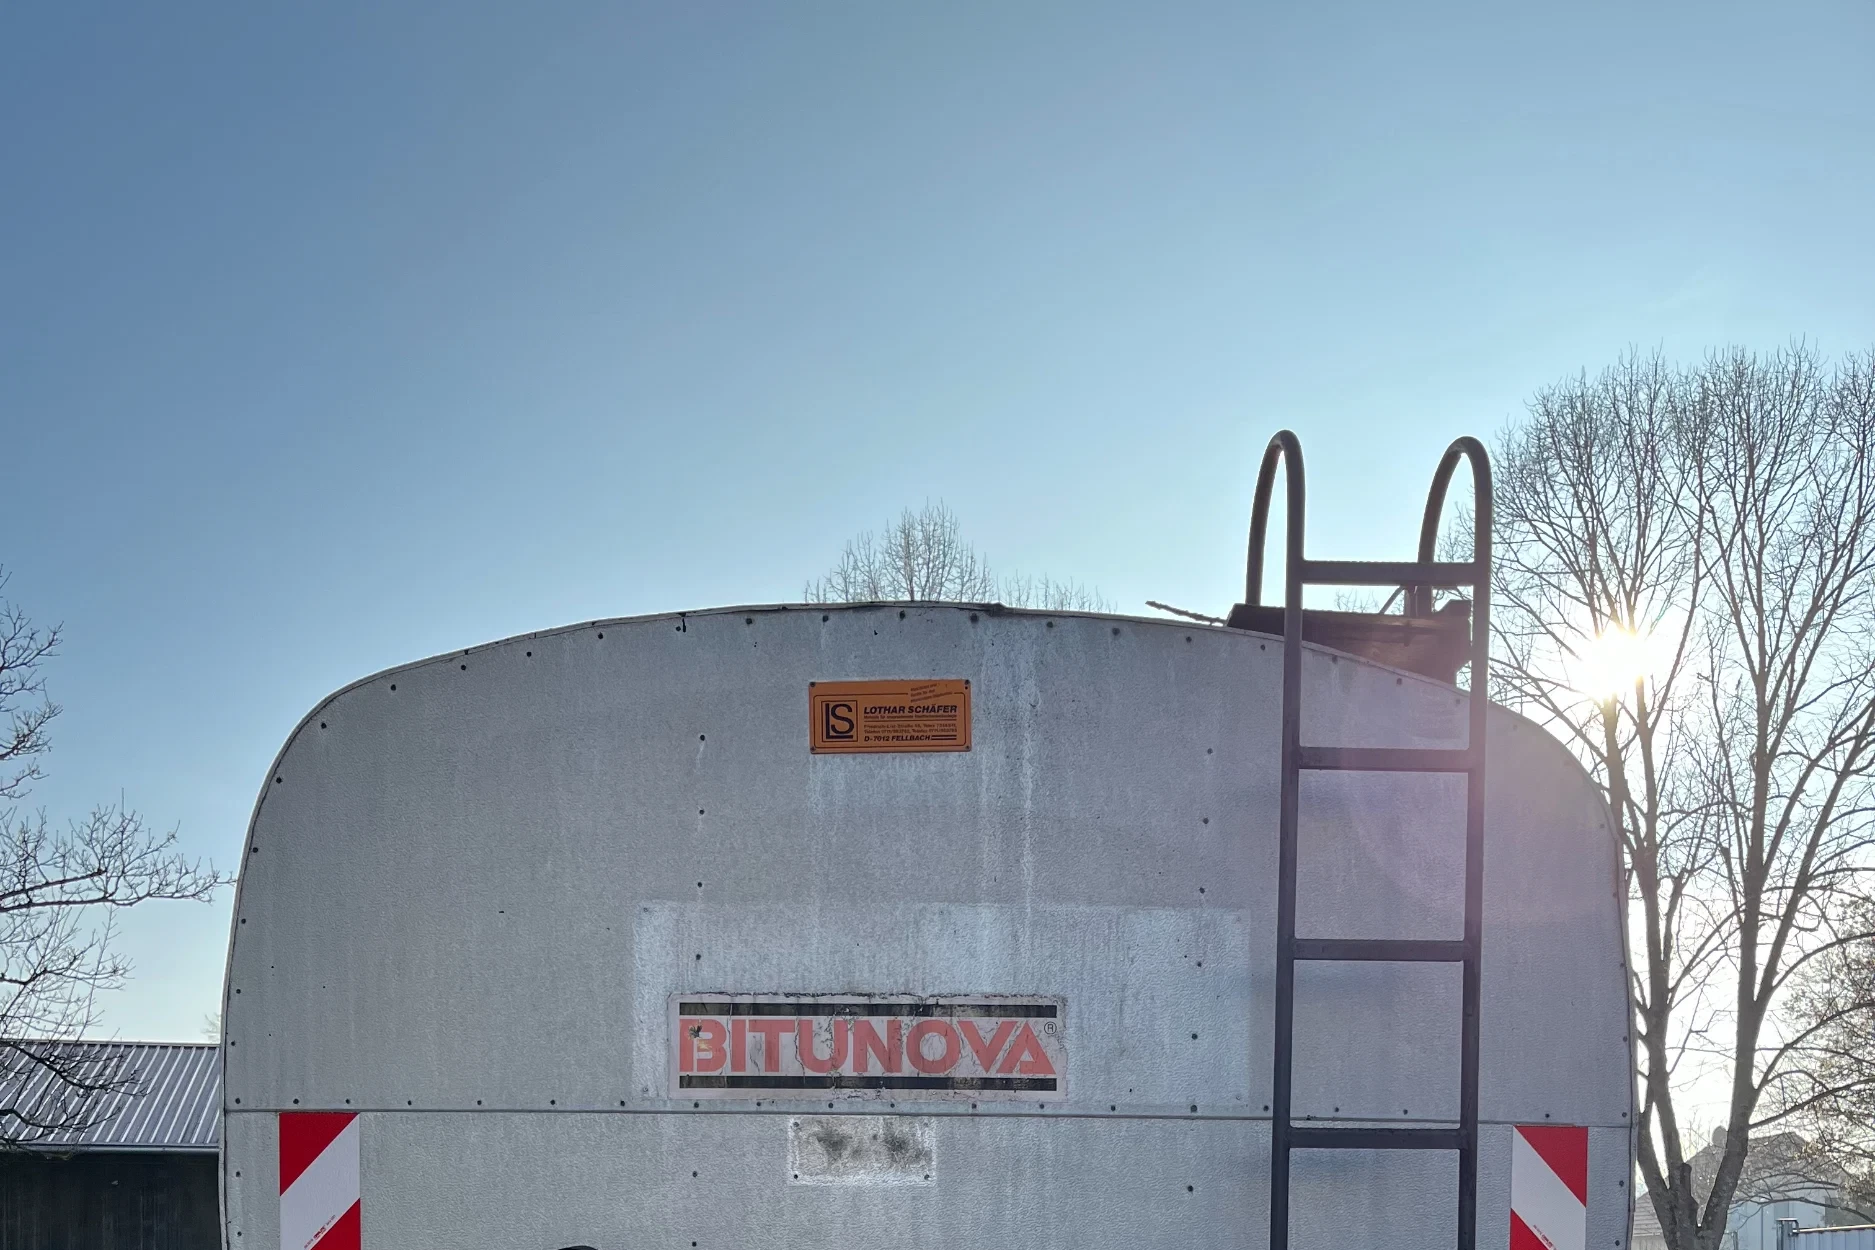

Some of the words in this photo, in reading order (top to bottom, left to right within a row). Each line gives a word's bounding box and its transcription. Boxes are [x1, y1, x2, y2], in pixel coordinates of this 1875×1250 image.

[864, 706, 904, 714] LOTHAR
[908, 704, 957, 714] SCHÄFER
[891, 734, 930, 742] FELLBACH
[679, 1018, 1056, 1075] BITUNOVA
